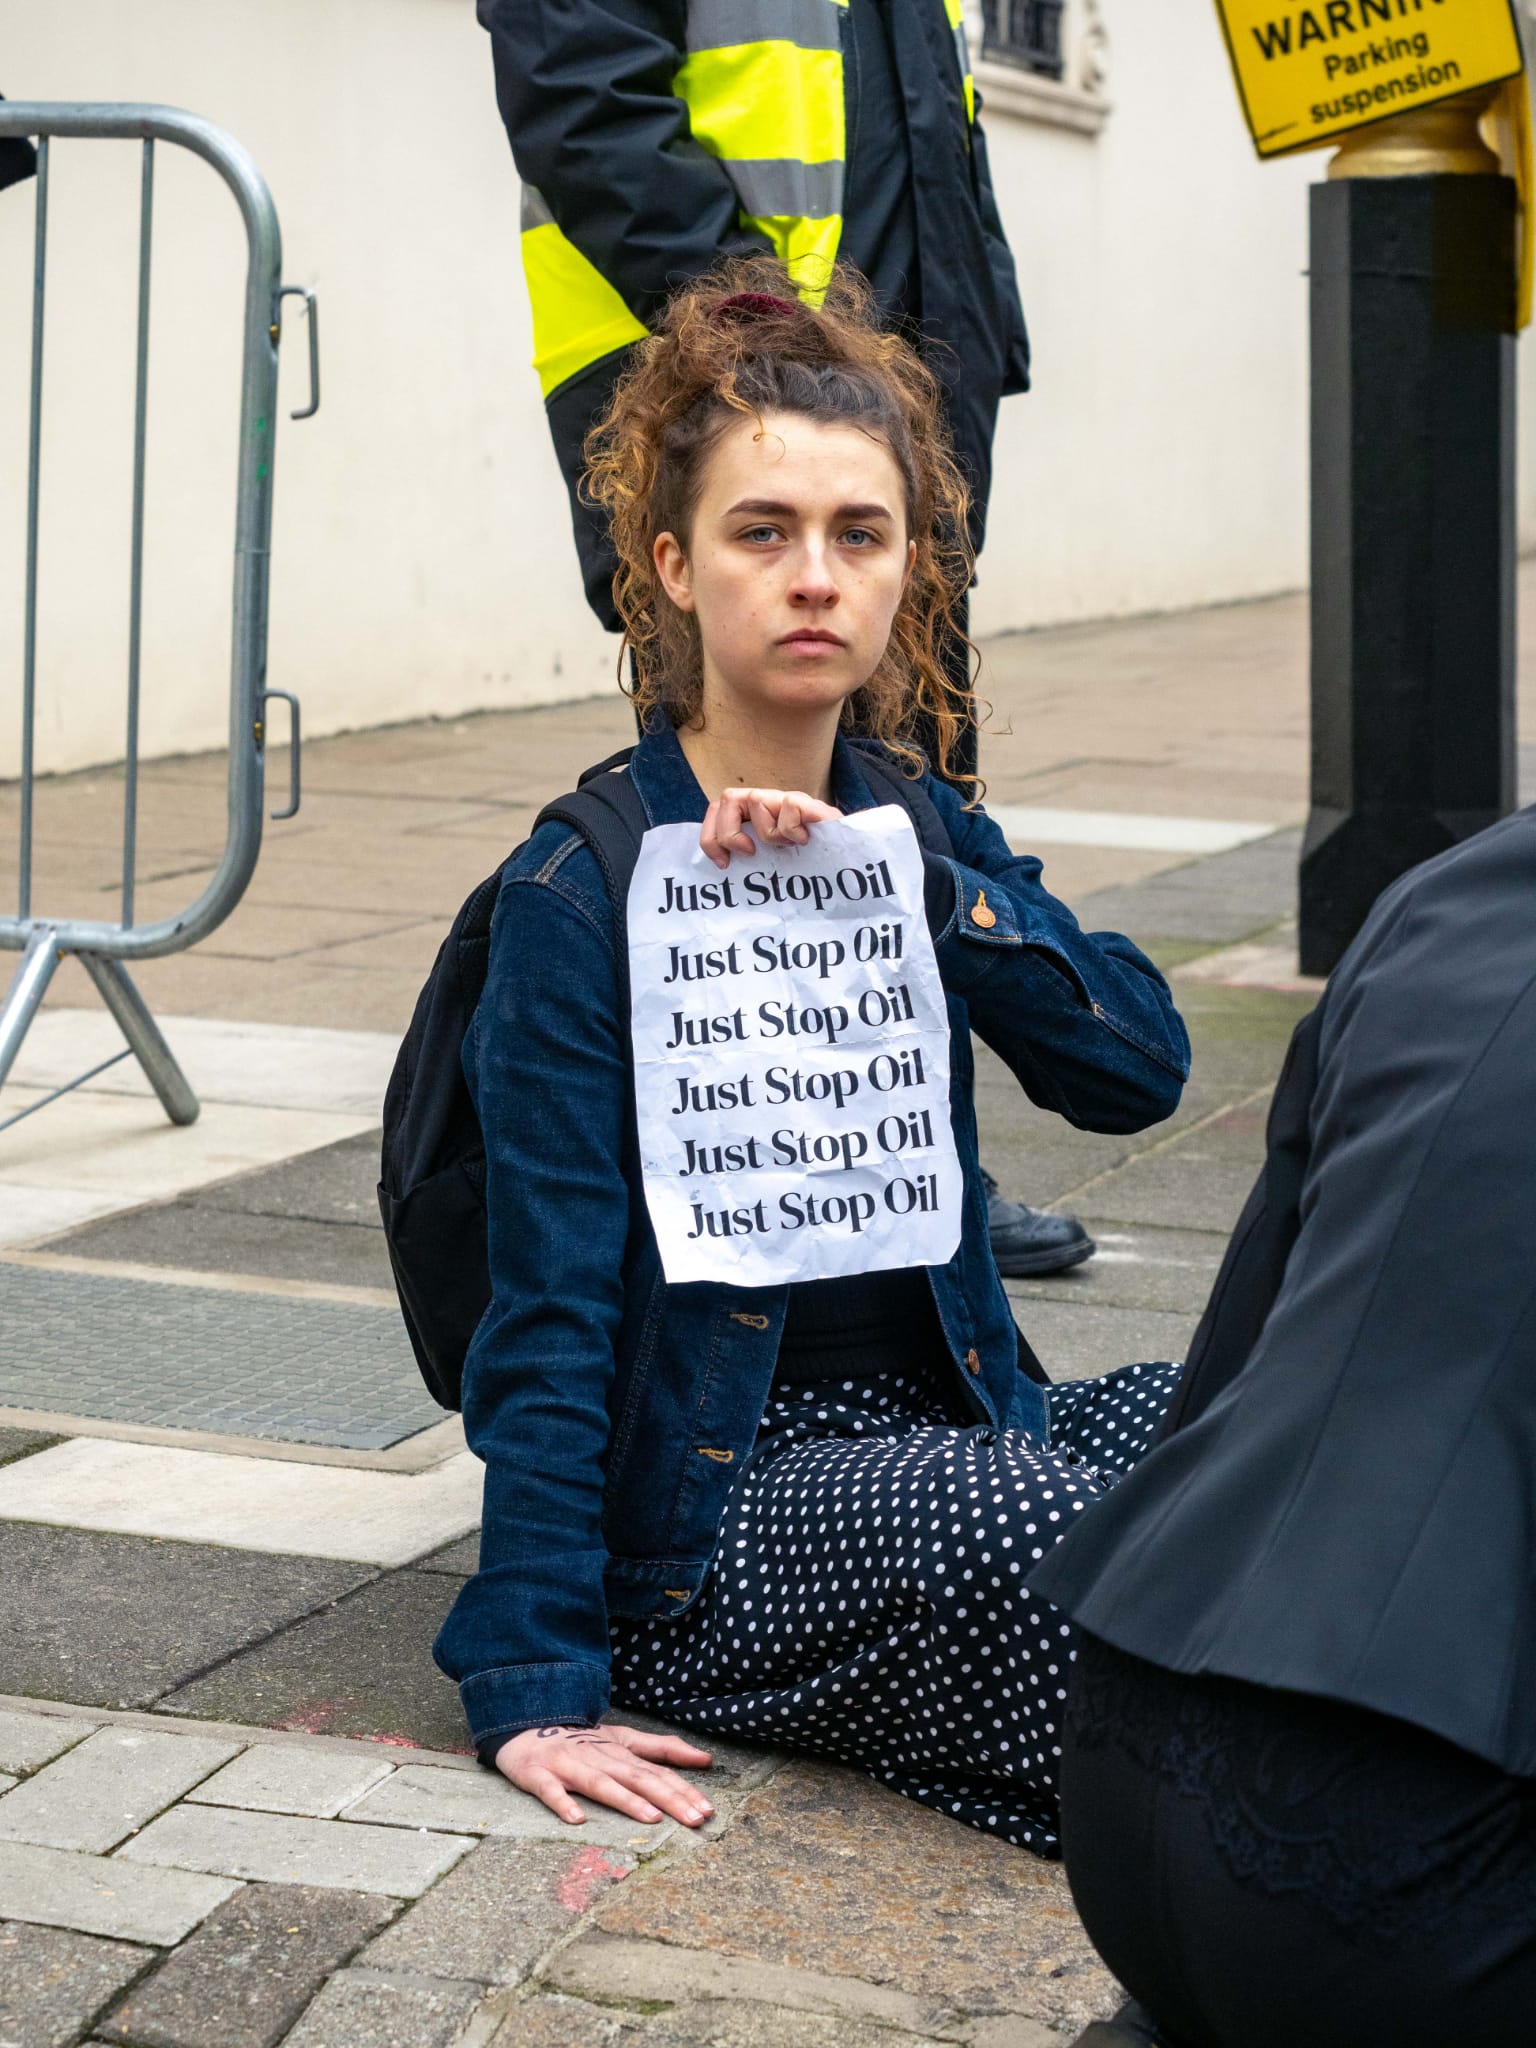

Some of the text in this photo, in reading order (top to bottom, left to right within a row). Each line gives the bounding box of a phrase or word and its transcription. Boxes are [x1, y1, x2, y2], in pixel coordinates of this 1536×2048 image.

[1252, 0, 1444, 61] WARN
[1323, 32, 1430, 80] Parking
[1309, 60, 1461, 124] suspension
[658, 859, 896, 914] Just Stop Oil
[663, 923, 904, 983] Just Stop Oil
[665, 983, 916, 1049] Just Stop Oil
[671, 1047, 927, 1115] Just Stop Oil
[678, 1109, 935, 1177] Just Stop Oil
[687, 1173, 940, 1239] Just Stop Oil
